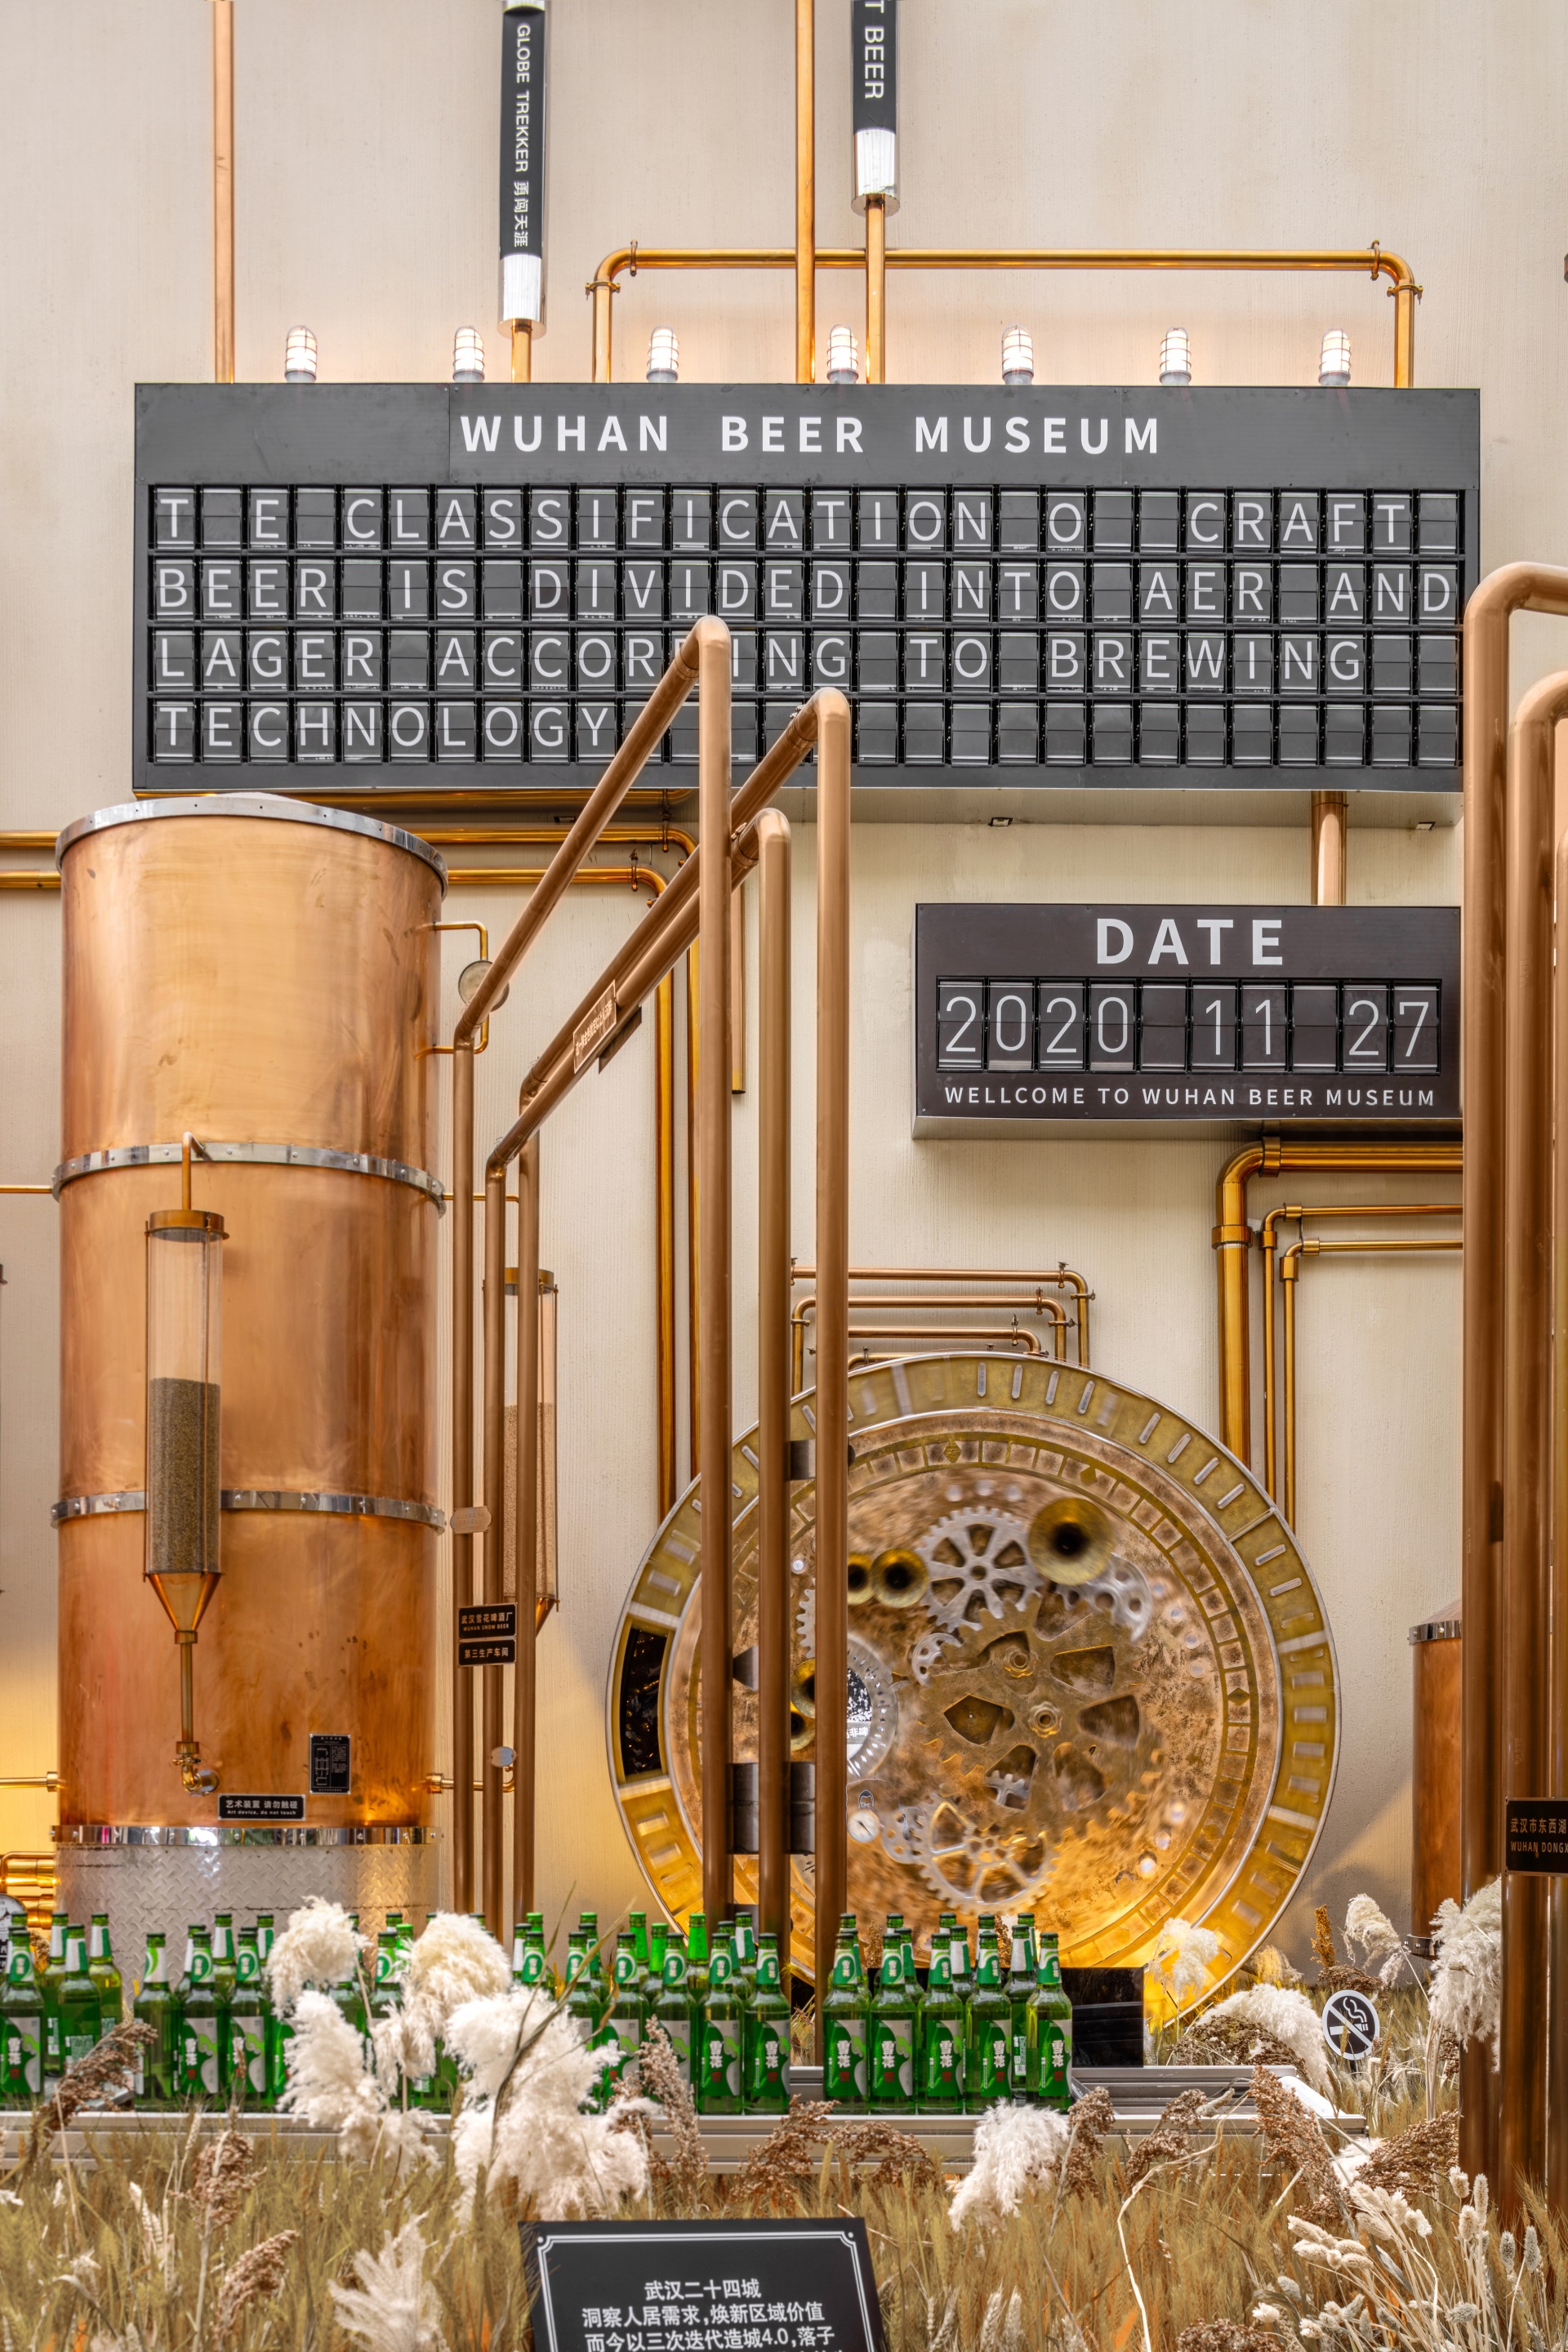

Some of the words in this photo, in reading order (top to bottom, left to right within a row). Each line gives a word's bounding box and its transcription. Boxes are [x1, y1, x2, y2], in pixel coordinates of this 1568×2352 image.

[516, 24, 532, 83] GLOBE
[865, 25, 884, 99] BEER
[515, 90, 530, 173] TREKKER
[514, 180, 529, 247] 勇闯天涯
[460, 415, 667, 453] WUHAN
[721, 415, 864, 453] BEER
[915, 416, 1158, 454] MUSEUM
[346, 498, 988, 542] CLASSIFICATION
[1190, 502, 1405, 543] CRAFT
[159, 568, 327, 609] BEER
[405, 568, 468, 610] IS
[535, 569, 844, 611] DIVIDED
[921, 571, 1080, 612] INTO
[1145, 571, 1264, 612] AER
[1330, 572, 1450, 612] AND
[161, 637, 374, 679] LAGER
[439, 637, 847, 679] ACCORING
[910, 639, 988, 679] TO
[1050, 639, 1360, 680] BREWING
[160, 706, 609, 748] TECHNOLOGY
[1097, 918, 1283, 965] DATE
[946, 995, 1128, 1054] 2020
[1205, 1000, 1271, 1055] 11
[1348, 1000, 1429, 1057] 27
[944, 1087, 1085, 1105] WELLCOME
[1098, 1088, 1129, 1105] TO
[1142, 1088, 1234, 1106] WUHAN
[1250, 1089, 1312, 1106] BEER
[1326, 1089, 1434, 1107] MUSEUM
[461, 1612, 513, 1624] 武汉雪花啤酒厂
[465, 1647, 508, 1659] 第三生产车间
[225, 1799, 261, 1809] 艺术装置
[264, 1800, 298, 1810] 请勿触碰
[1510, 1818, 1566, 1834] 武汉市东西湖
[1510, 1841, 1539, 1852] WUHAN
[644, 2278, 762, 2301] 武汉二十四城
